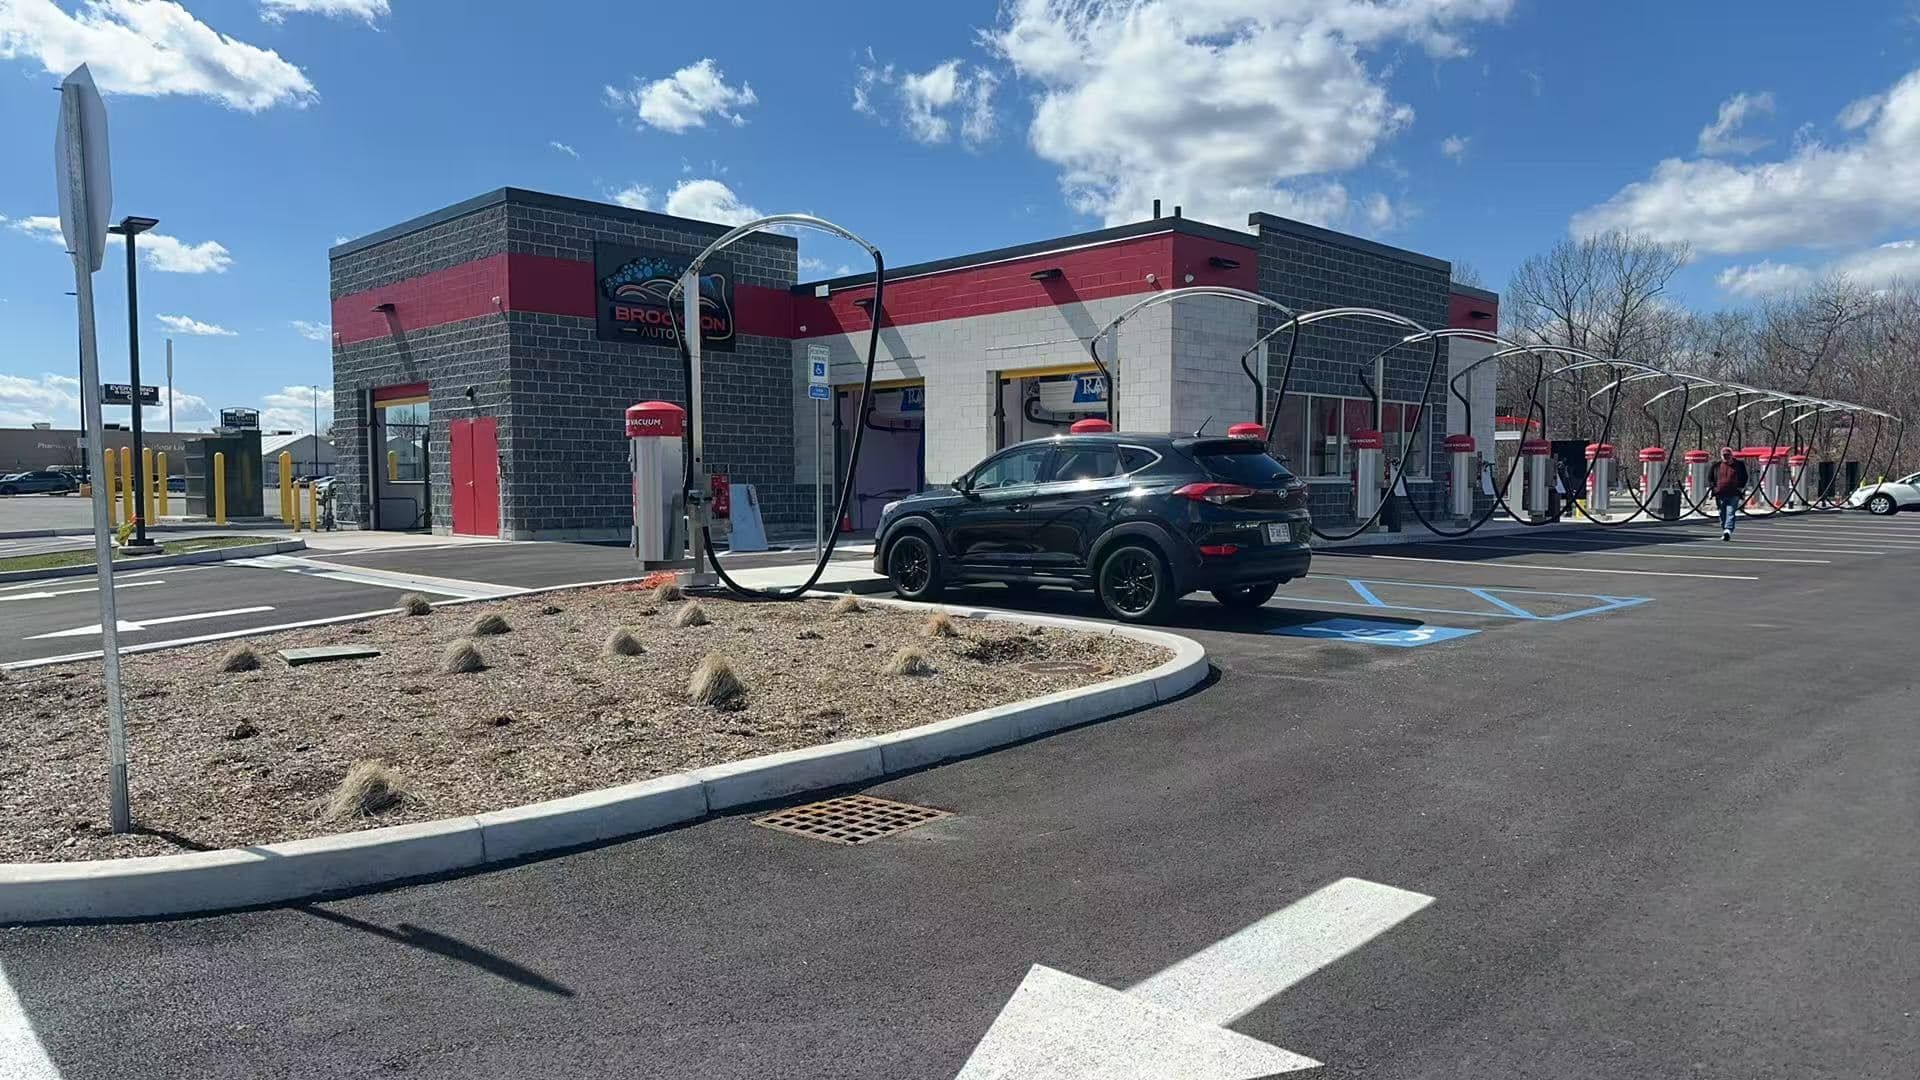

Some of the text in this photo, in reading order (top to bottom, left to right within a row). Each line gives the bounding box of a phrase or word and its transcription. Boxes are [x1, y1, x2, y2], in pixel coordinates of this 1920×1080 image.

[615, 306, 726, 331] BROCKON
[640, 326, 676, 340] AUTO
[630, 418, 662, 426] VACUUM
